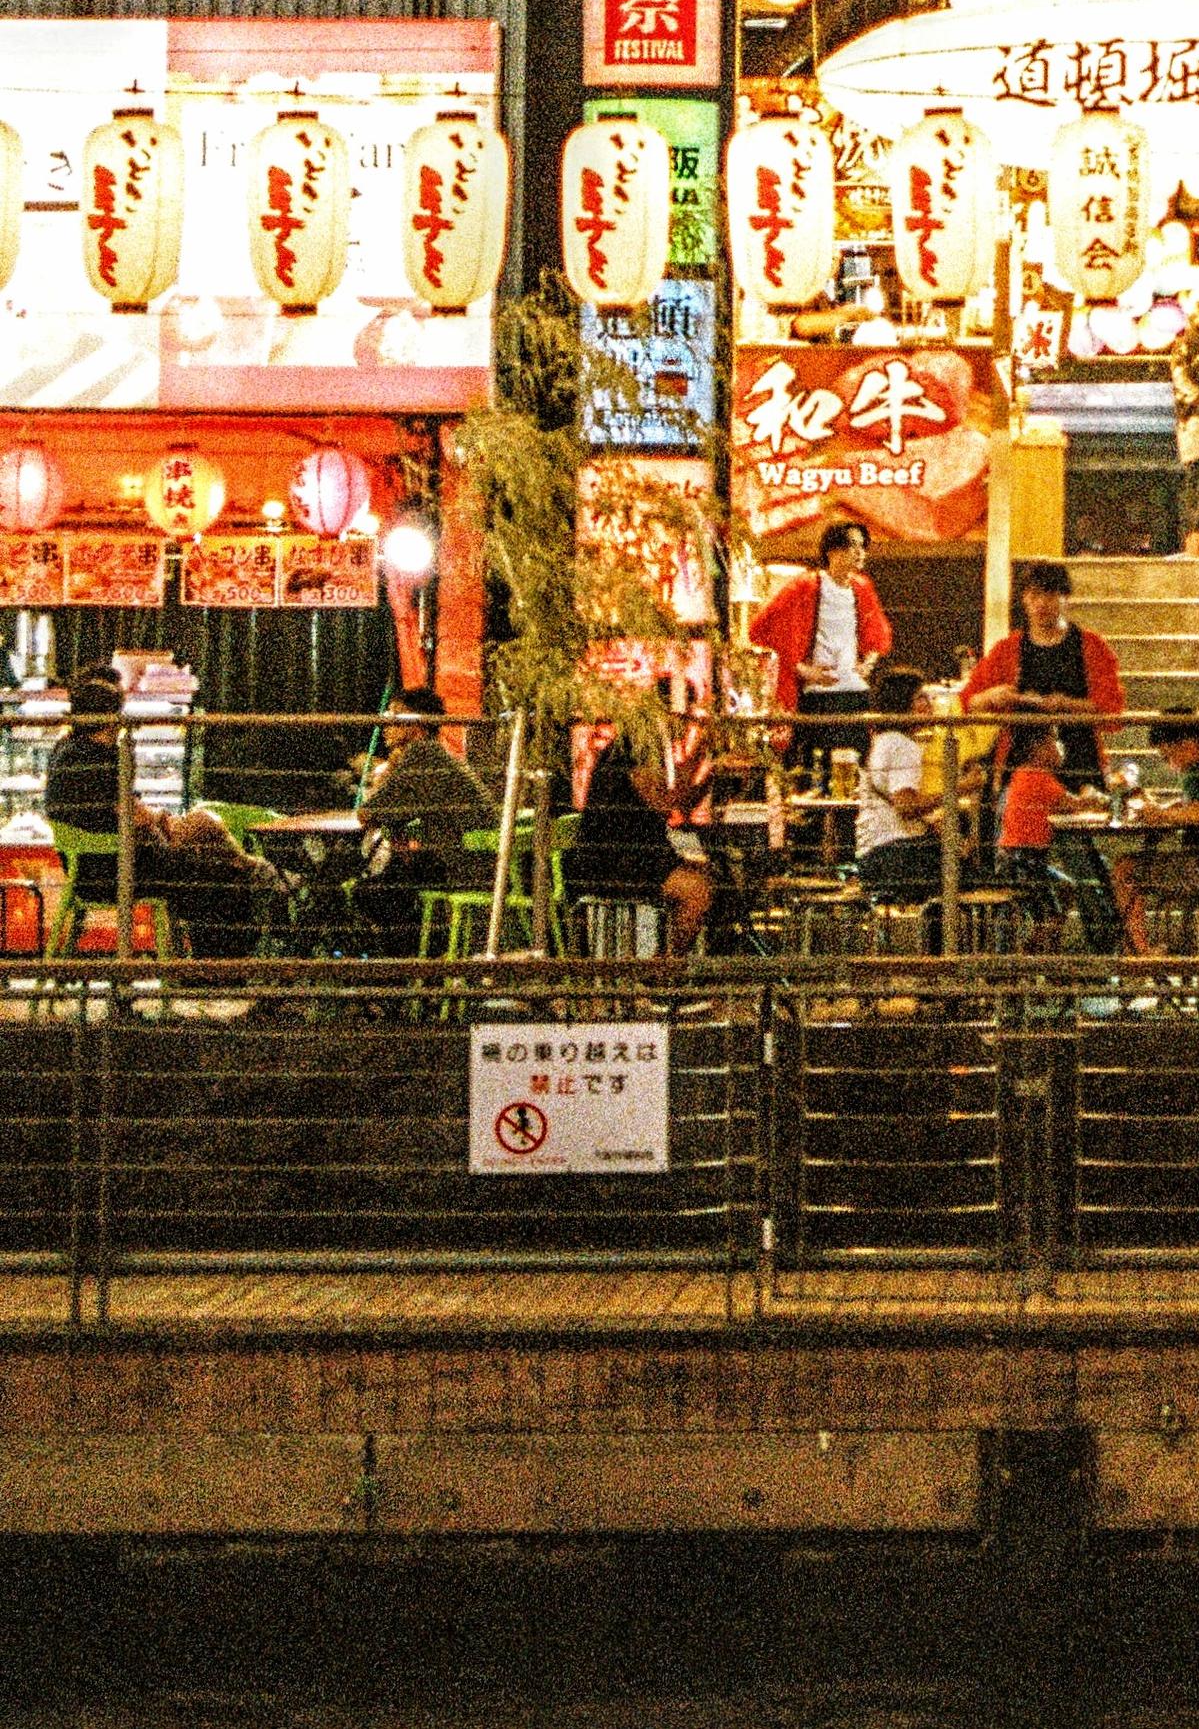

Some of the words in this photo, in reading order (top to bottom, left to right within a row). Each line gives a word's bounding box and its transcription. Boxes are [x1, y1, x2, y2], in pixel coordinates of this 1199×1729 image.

[614, 39, 685, 61] FESTIVAL
[744, 360, 948, 455] 和牛
[757, 461, 851, 492] Wagyu
[857, 460, 925, 485] Beef
[530, 1074, 627, 1095] 禁止です
